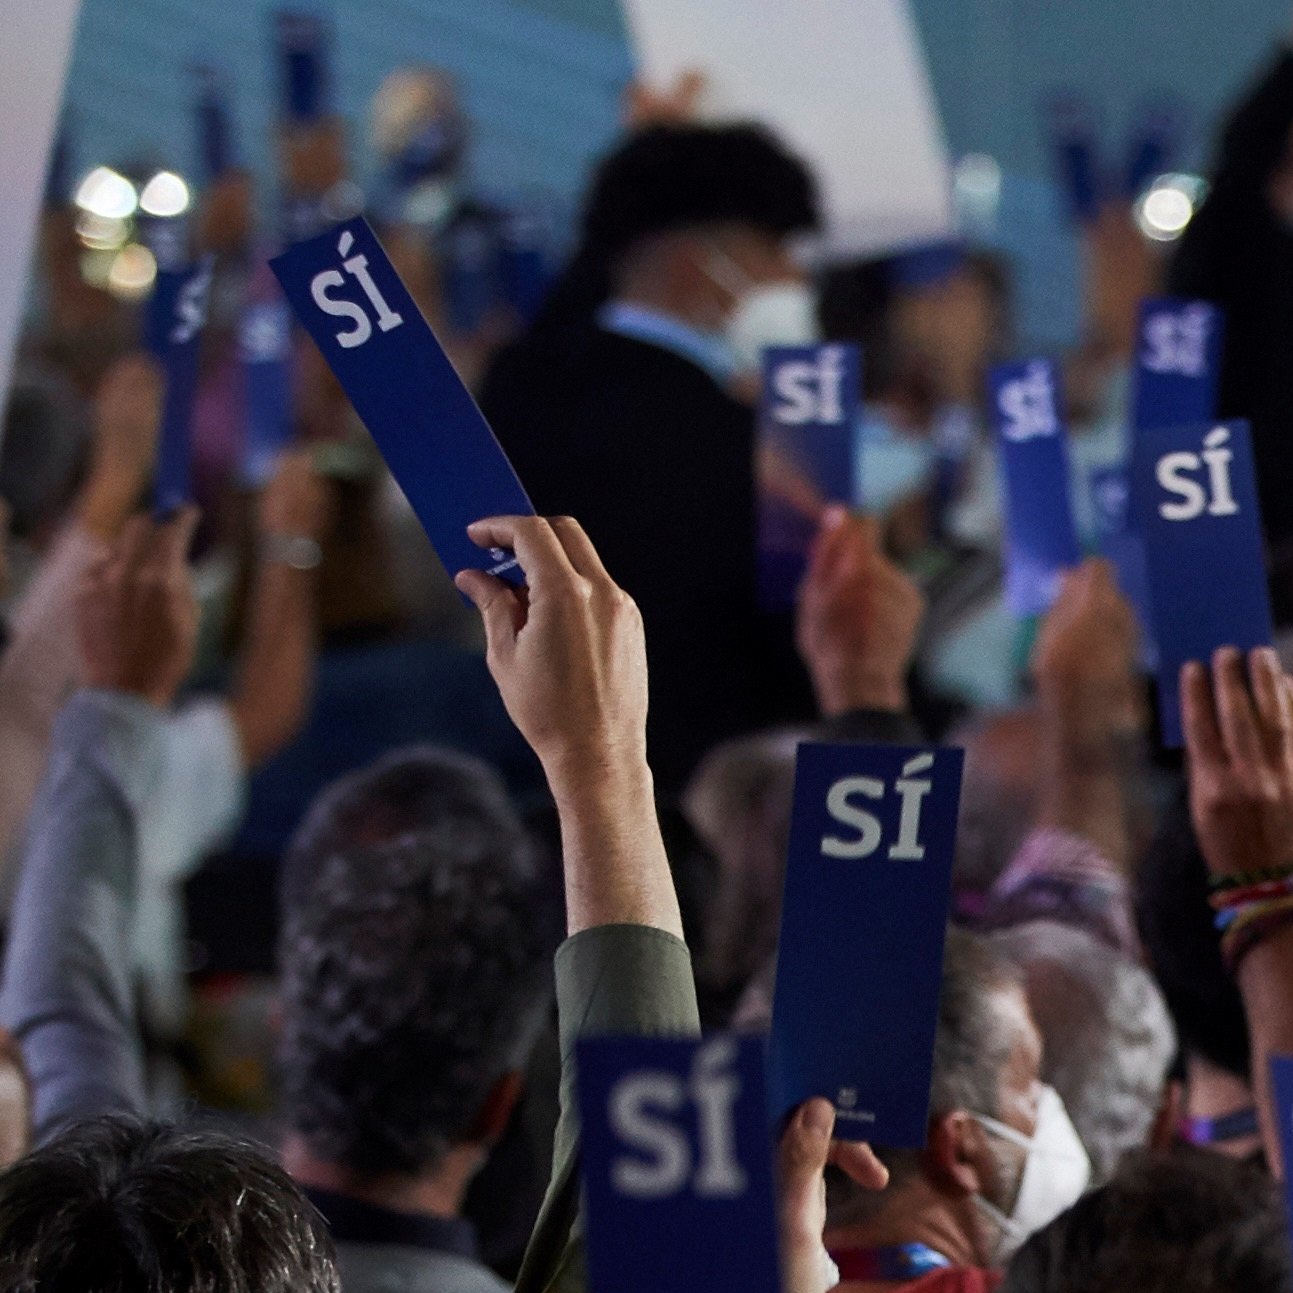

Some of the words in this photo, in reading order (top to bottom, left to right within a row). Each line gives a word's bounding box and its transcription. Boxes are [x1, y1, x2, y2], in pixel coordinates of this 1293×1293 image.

[311, 231, 403, 348] SÍ
[774, 346, 844, 424] SÍ
[1000, 358, 1058, 442] SÍ
[1156, 426, 1239, 520] SÍ
[820, 753, 933, 860] SÍ
[608, 1040, 748, 1196] SÍ
